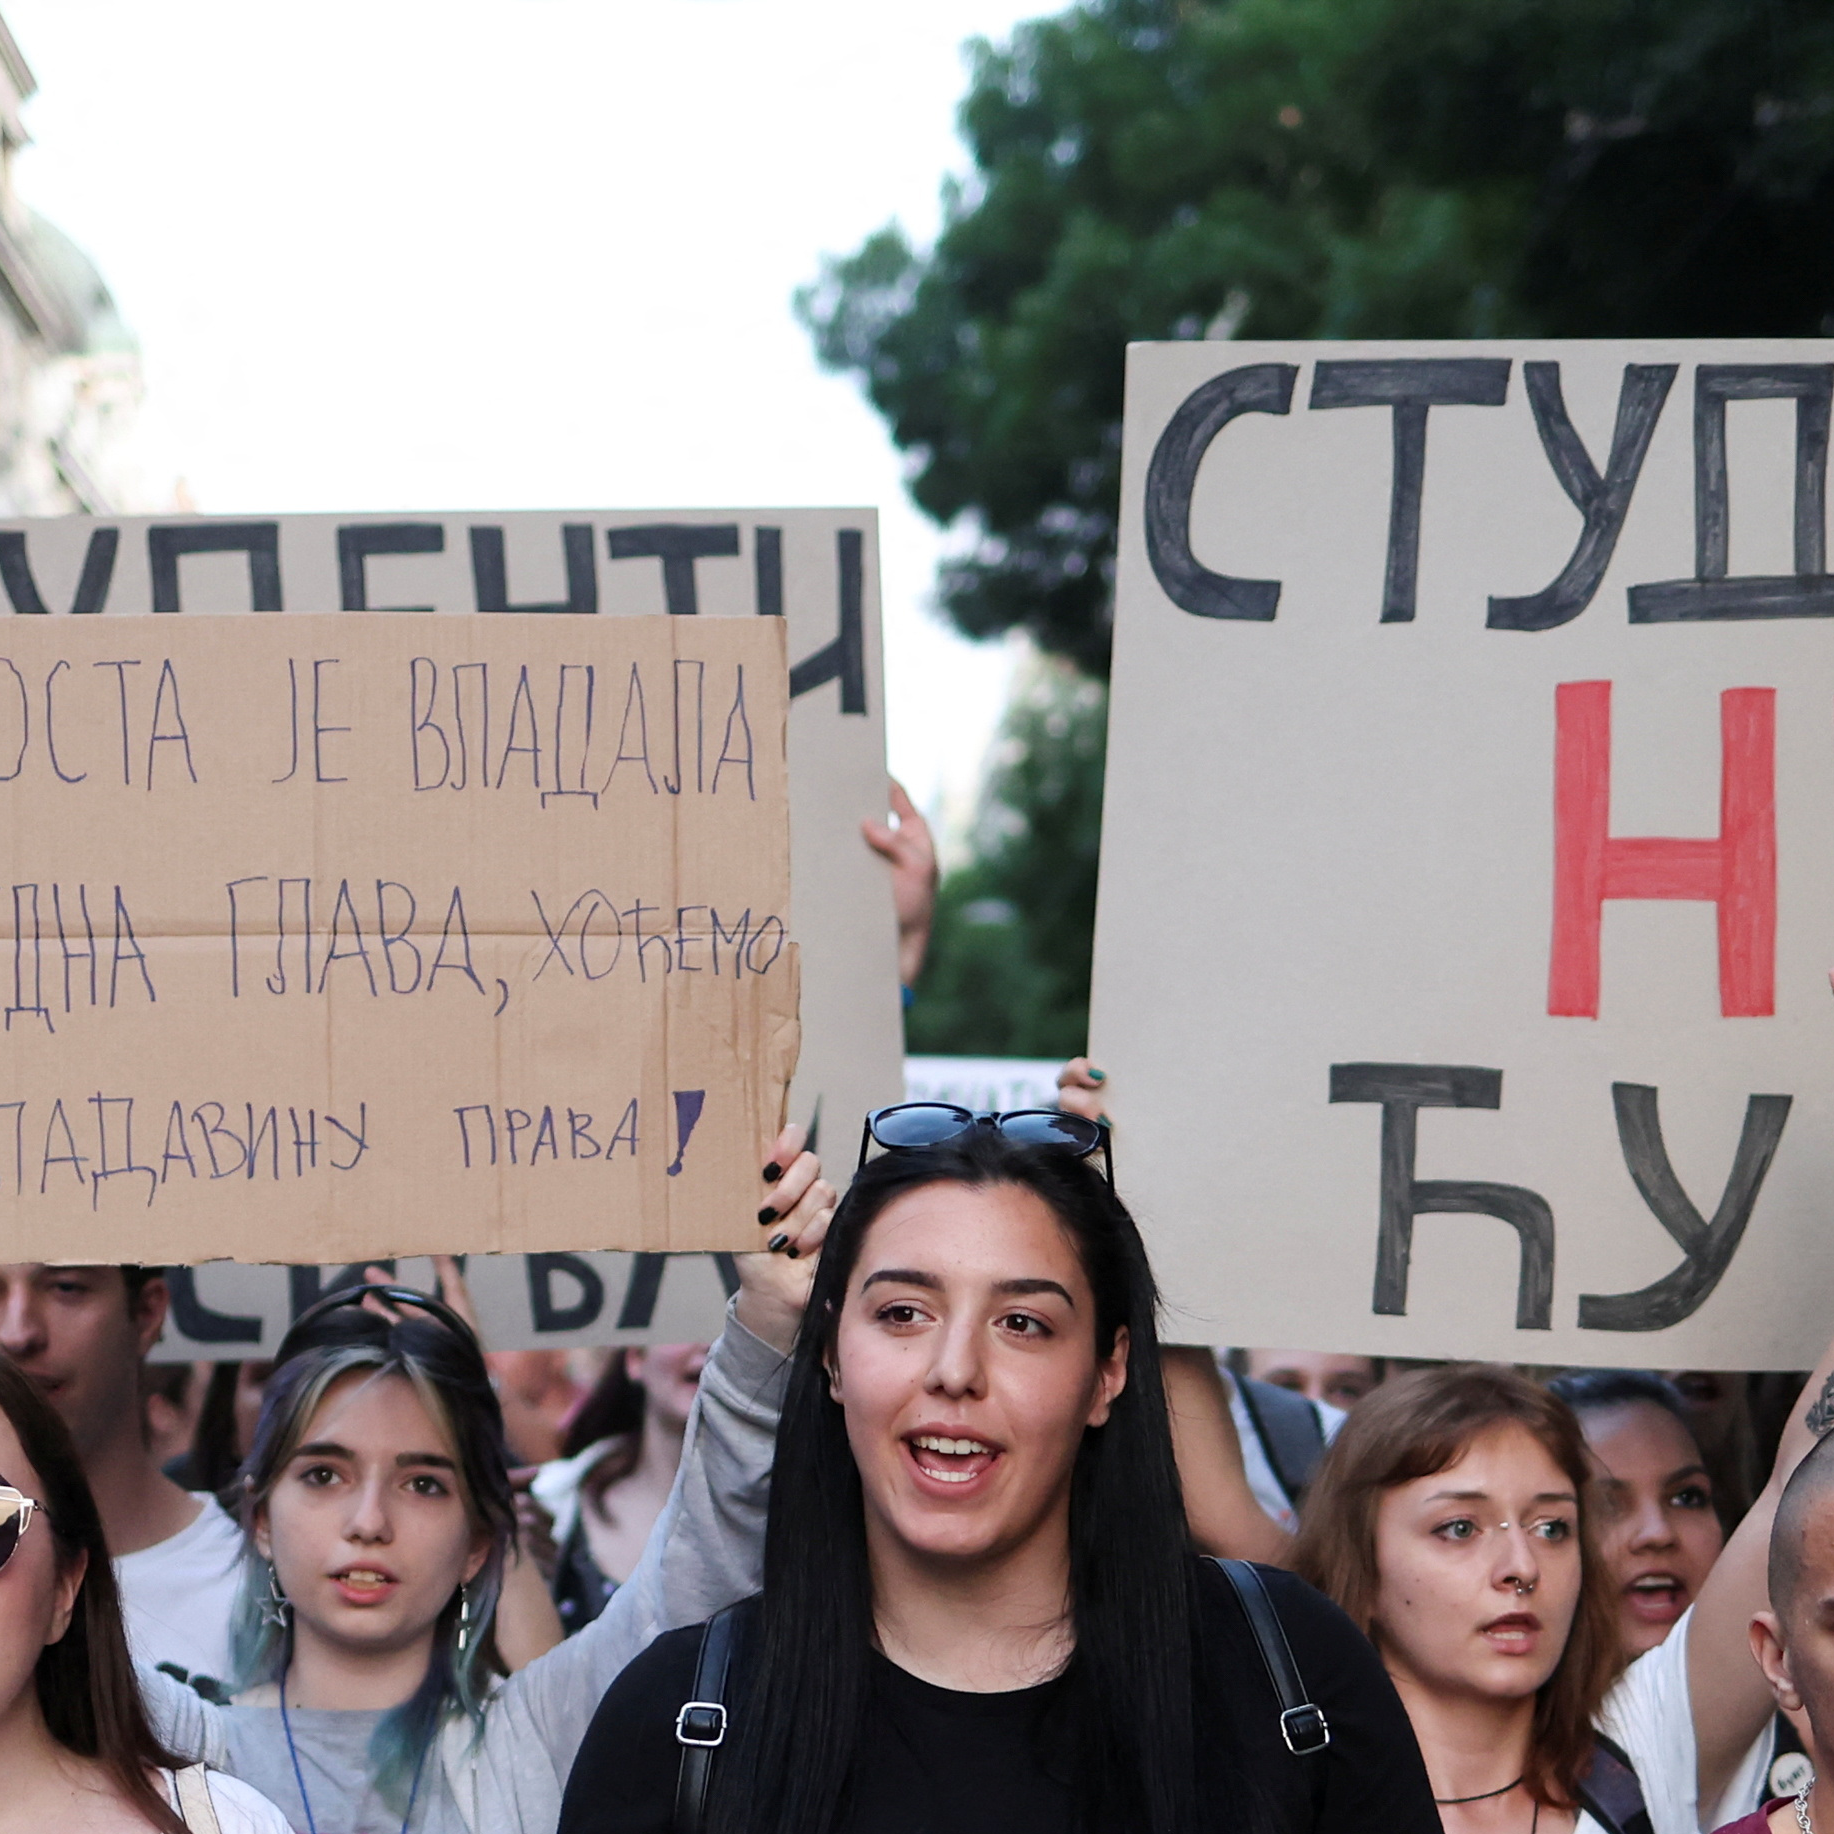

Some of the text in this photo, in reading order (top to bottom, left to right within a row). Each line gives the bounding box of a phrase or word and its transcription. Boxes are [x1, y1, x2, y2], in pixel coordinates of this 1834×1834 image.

[272, 657, 353, 784] ЈЕ
[411, 656, 757, 810] ВЛАДАЛА
[227, 877, 508, 1016] ГЛАВА,
[531, 889, 785, 983] ХОЋЕМО
